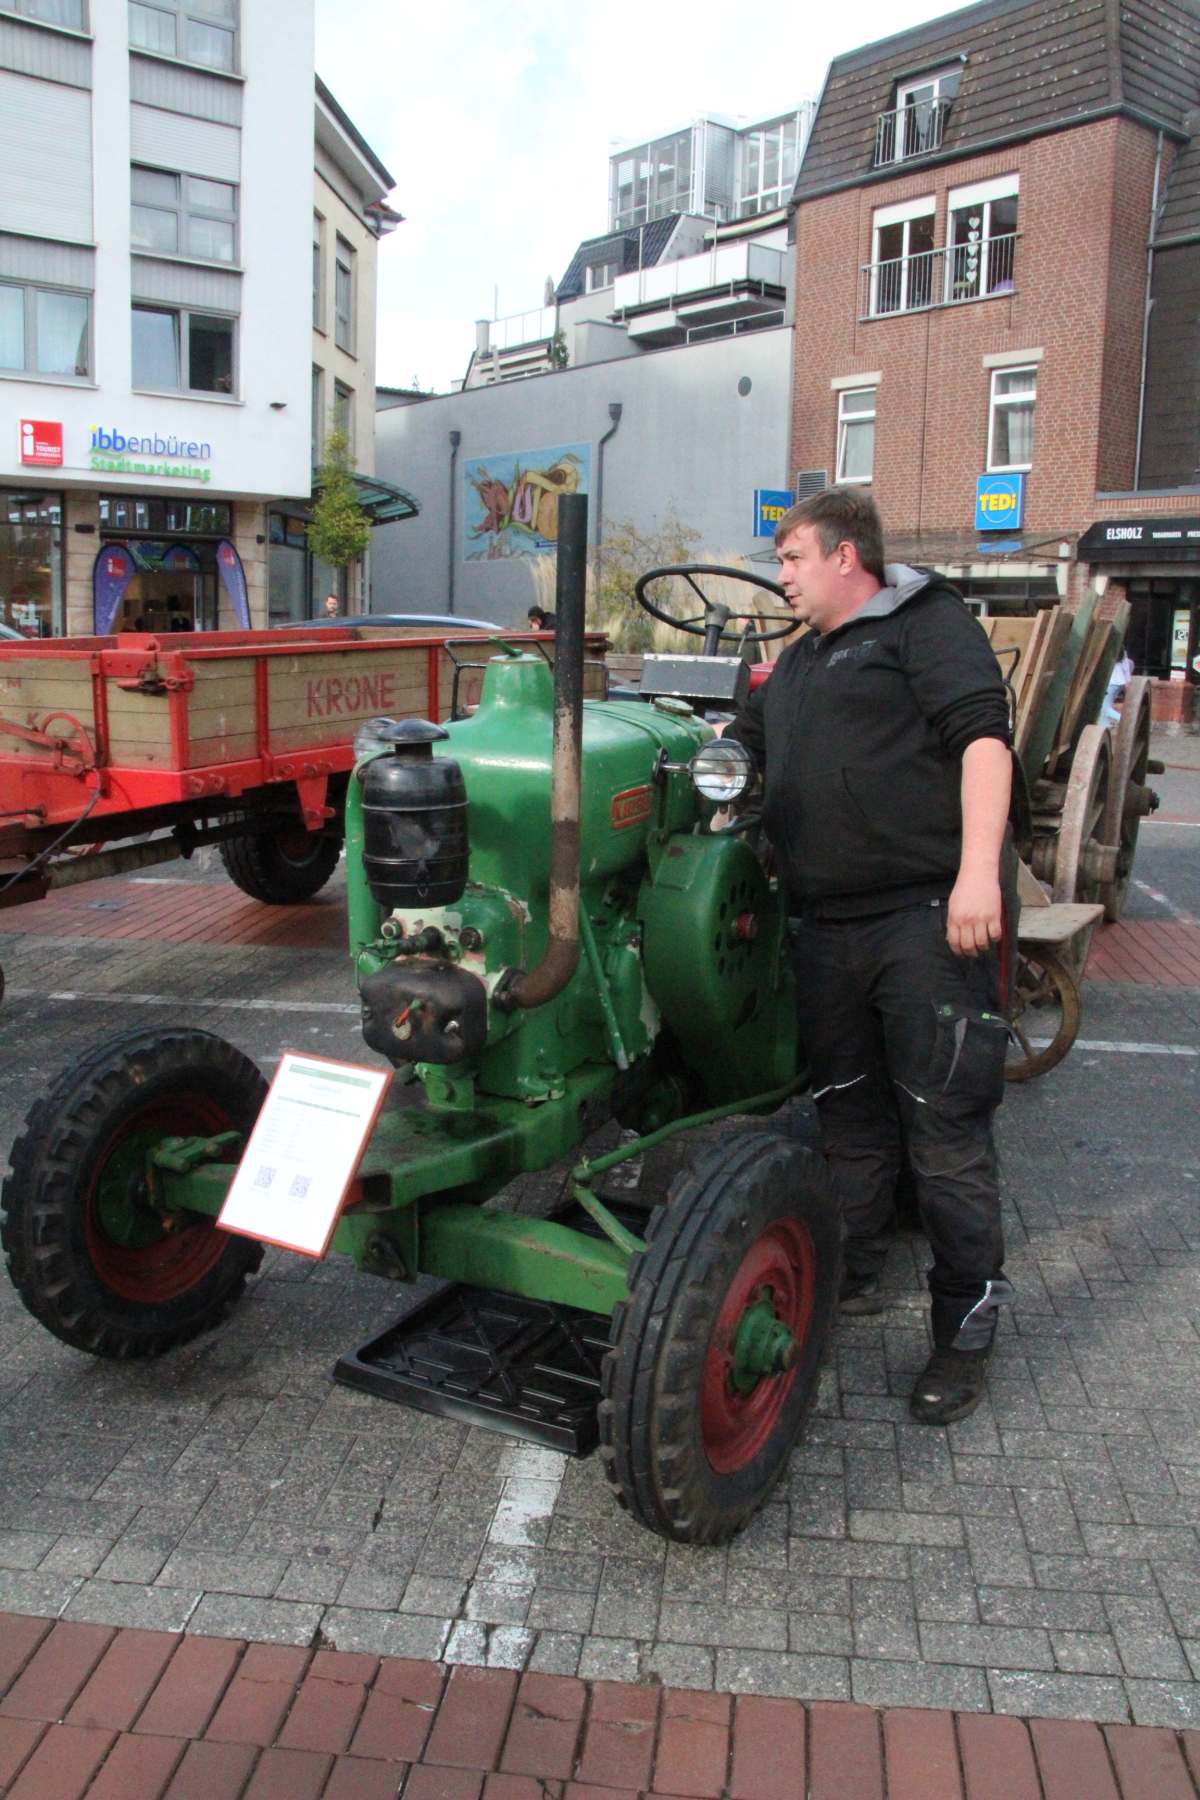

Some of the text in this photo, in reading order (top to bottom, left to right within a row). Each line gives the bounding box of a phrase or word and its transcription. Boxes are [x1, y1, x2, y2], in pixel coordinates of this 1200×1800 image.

[89, 423, 211, 459] ibbenbüren
[90, 456, 211, 483] Stadtmarketing
[761, 504, 788, 521] TED
[979, 492, 1017, 512] TEDi
[1106, 527, 1143, 540] ELSHOLZ
[306, 672, 397, 718] KRONE
